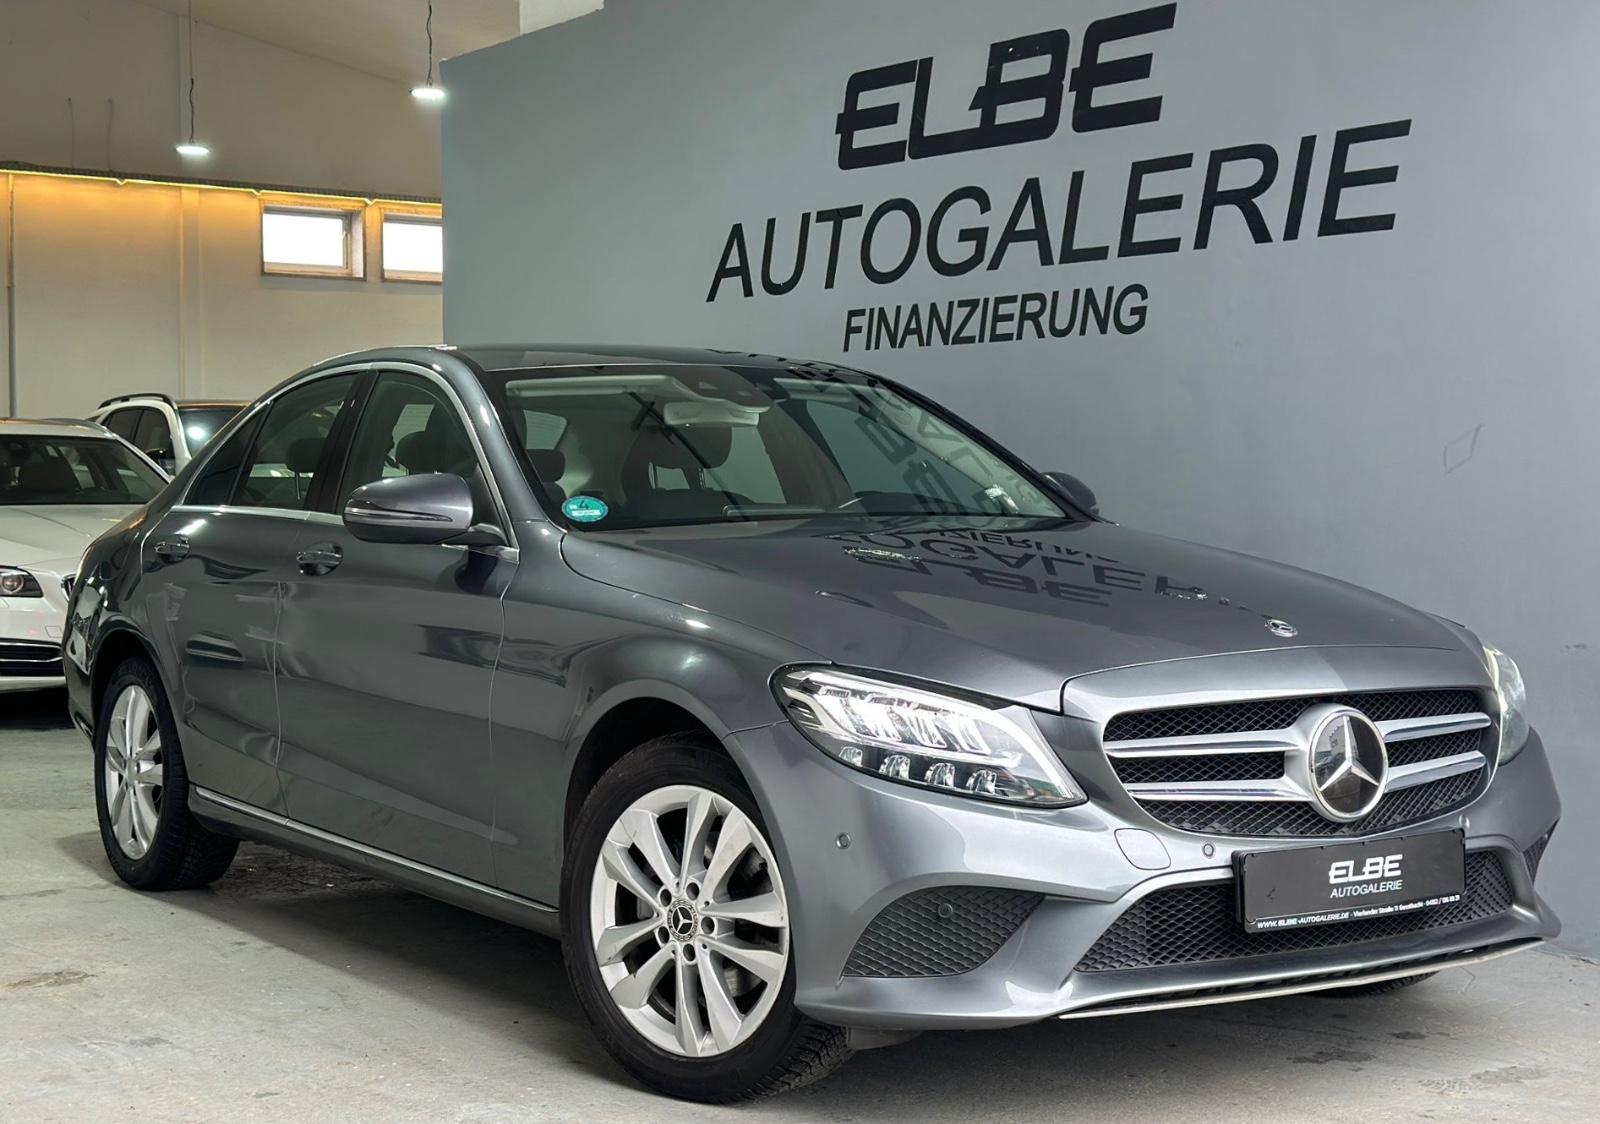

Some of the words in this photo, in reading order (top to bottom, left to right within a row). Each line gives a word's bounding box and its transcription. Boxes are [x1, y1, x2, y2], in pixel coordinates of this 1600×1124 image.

[835, 2, 1177, 170] ELBE
[706, 119, 1412, 302] AUTOGALERIE
[843, 283, 1148, 352] FINANZIERUNG
[1328, 853, 1403, 884] ELBE
[1329, 879, 1403, 899] AUTOGALERIE
